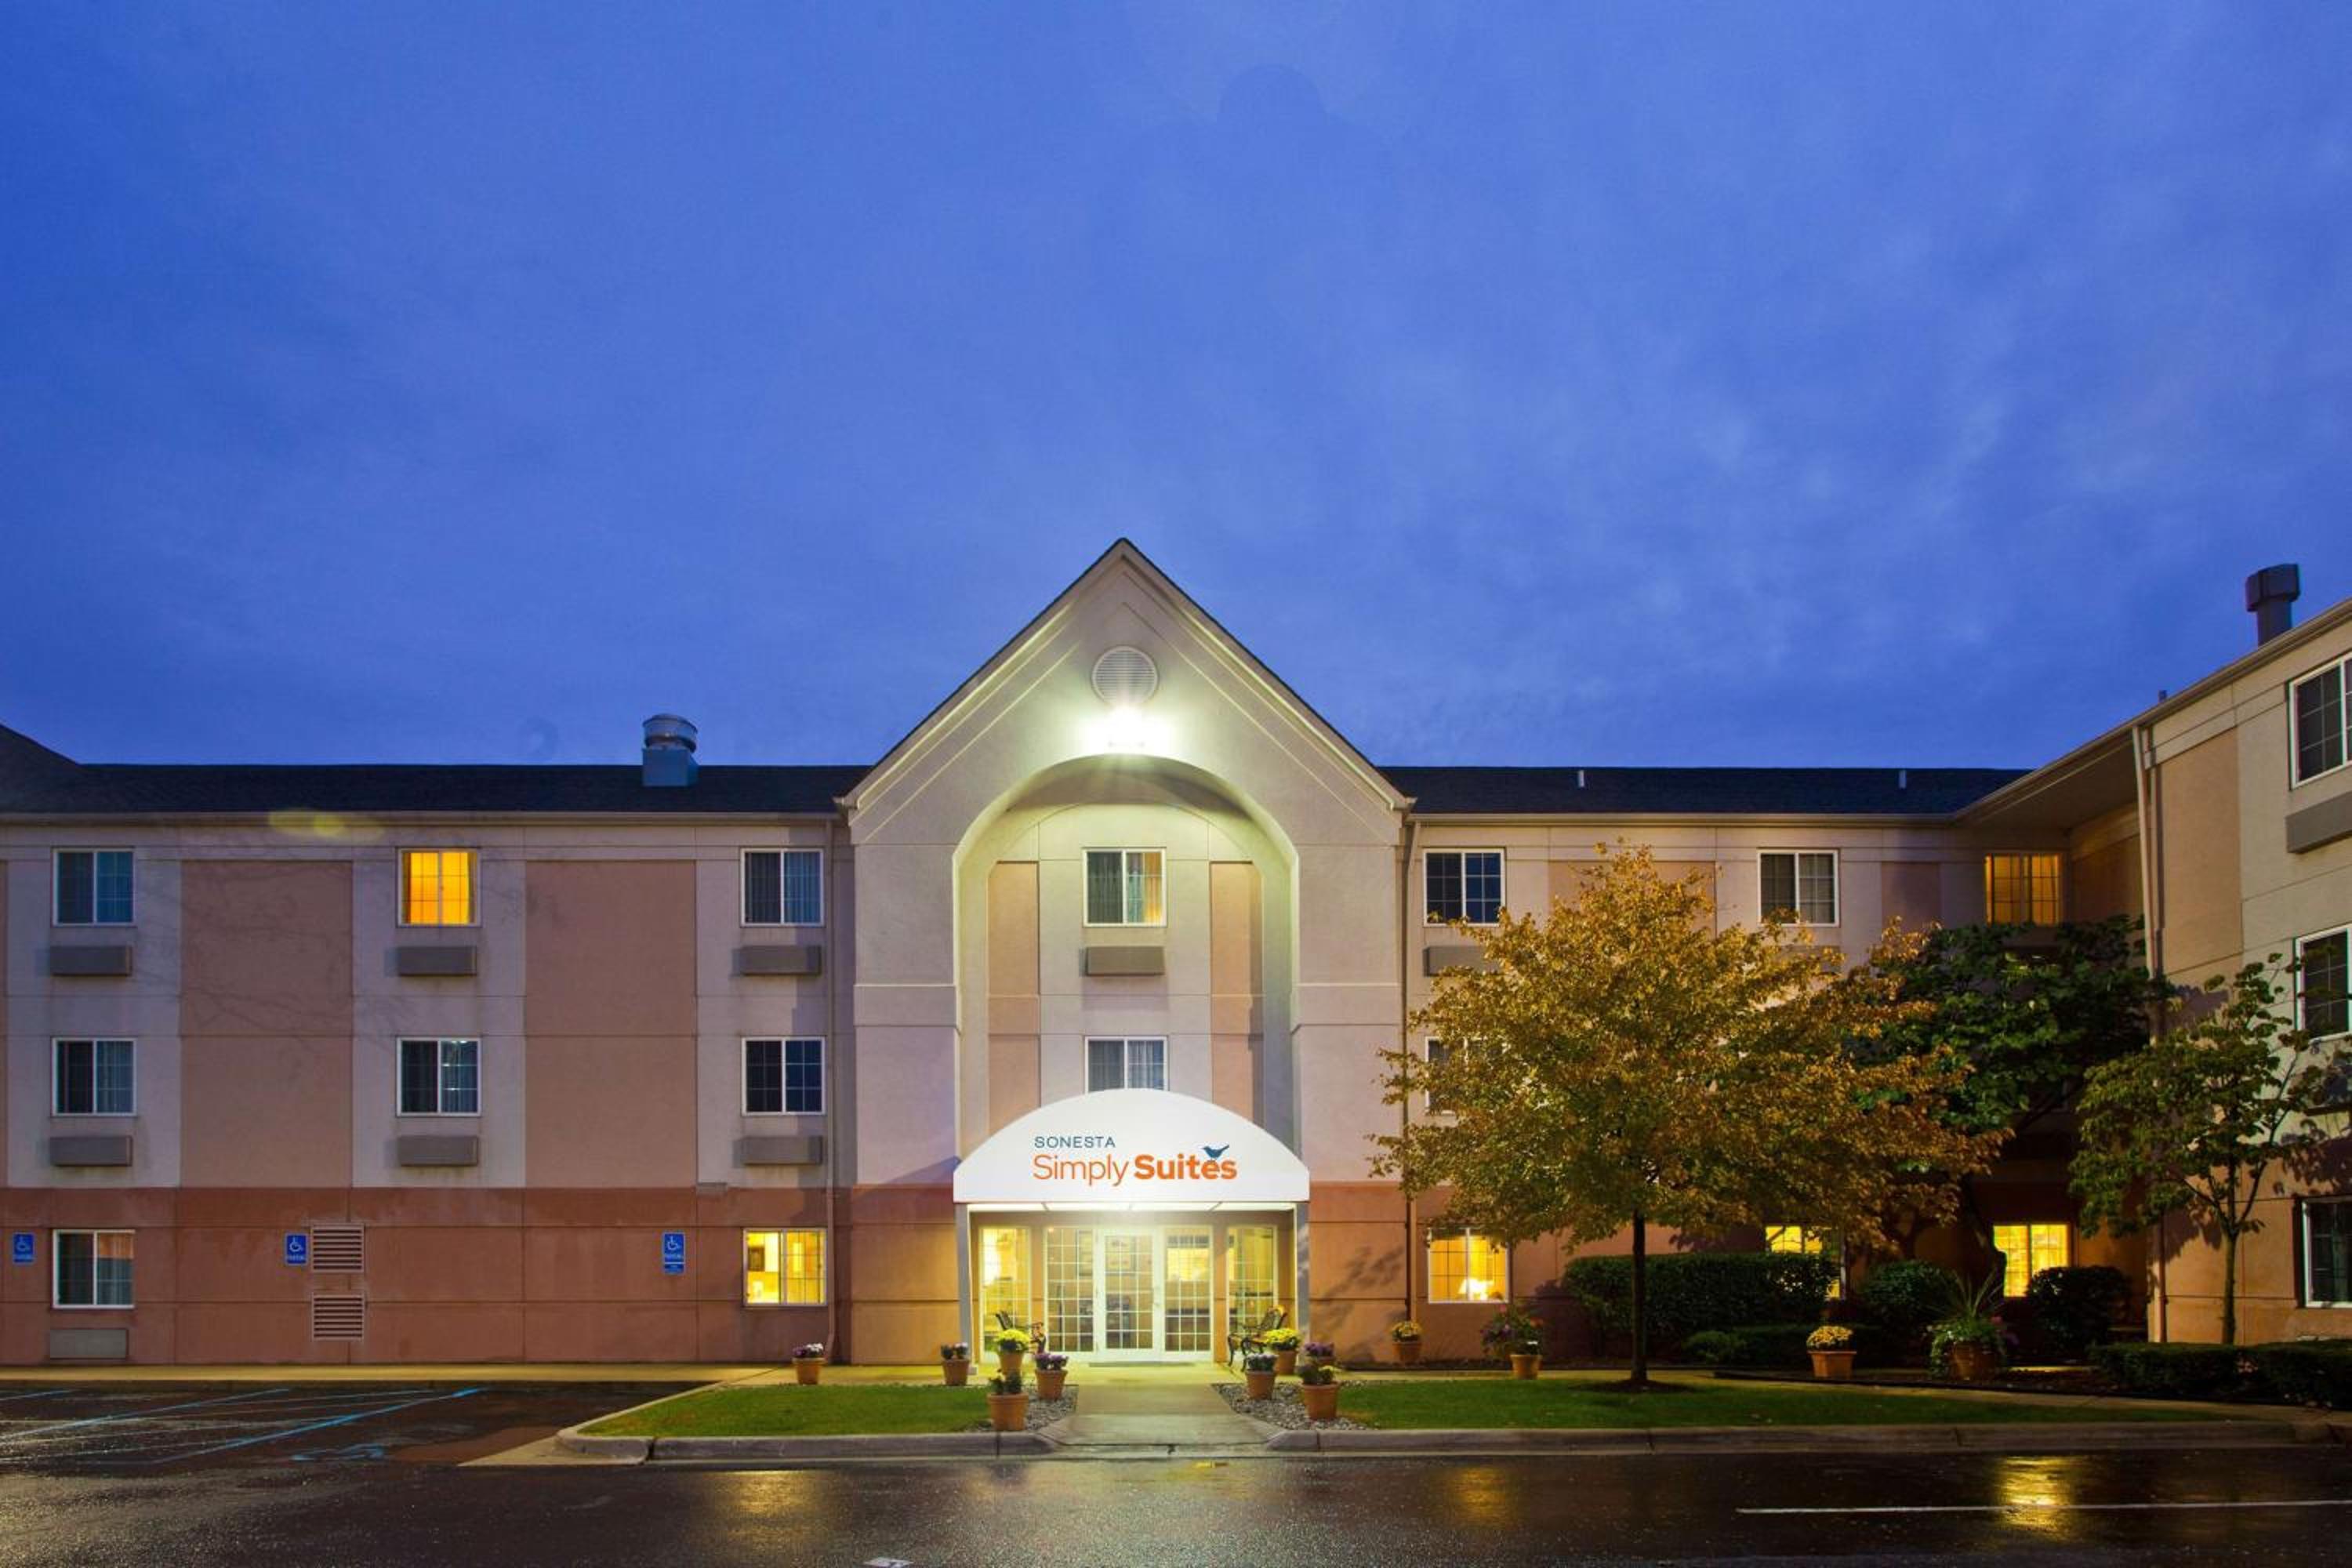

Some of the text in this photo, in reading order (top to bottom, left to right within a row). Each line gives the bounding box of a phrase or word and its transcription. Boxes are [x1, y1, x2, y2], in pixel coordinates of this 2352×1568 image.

[1034, 1136, 1116, 1149] SONESTA
[1033, 1153, 1238, 1186] Simply Suites
